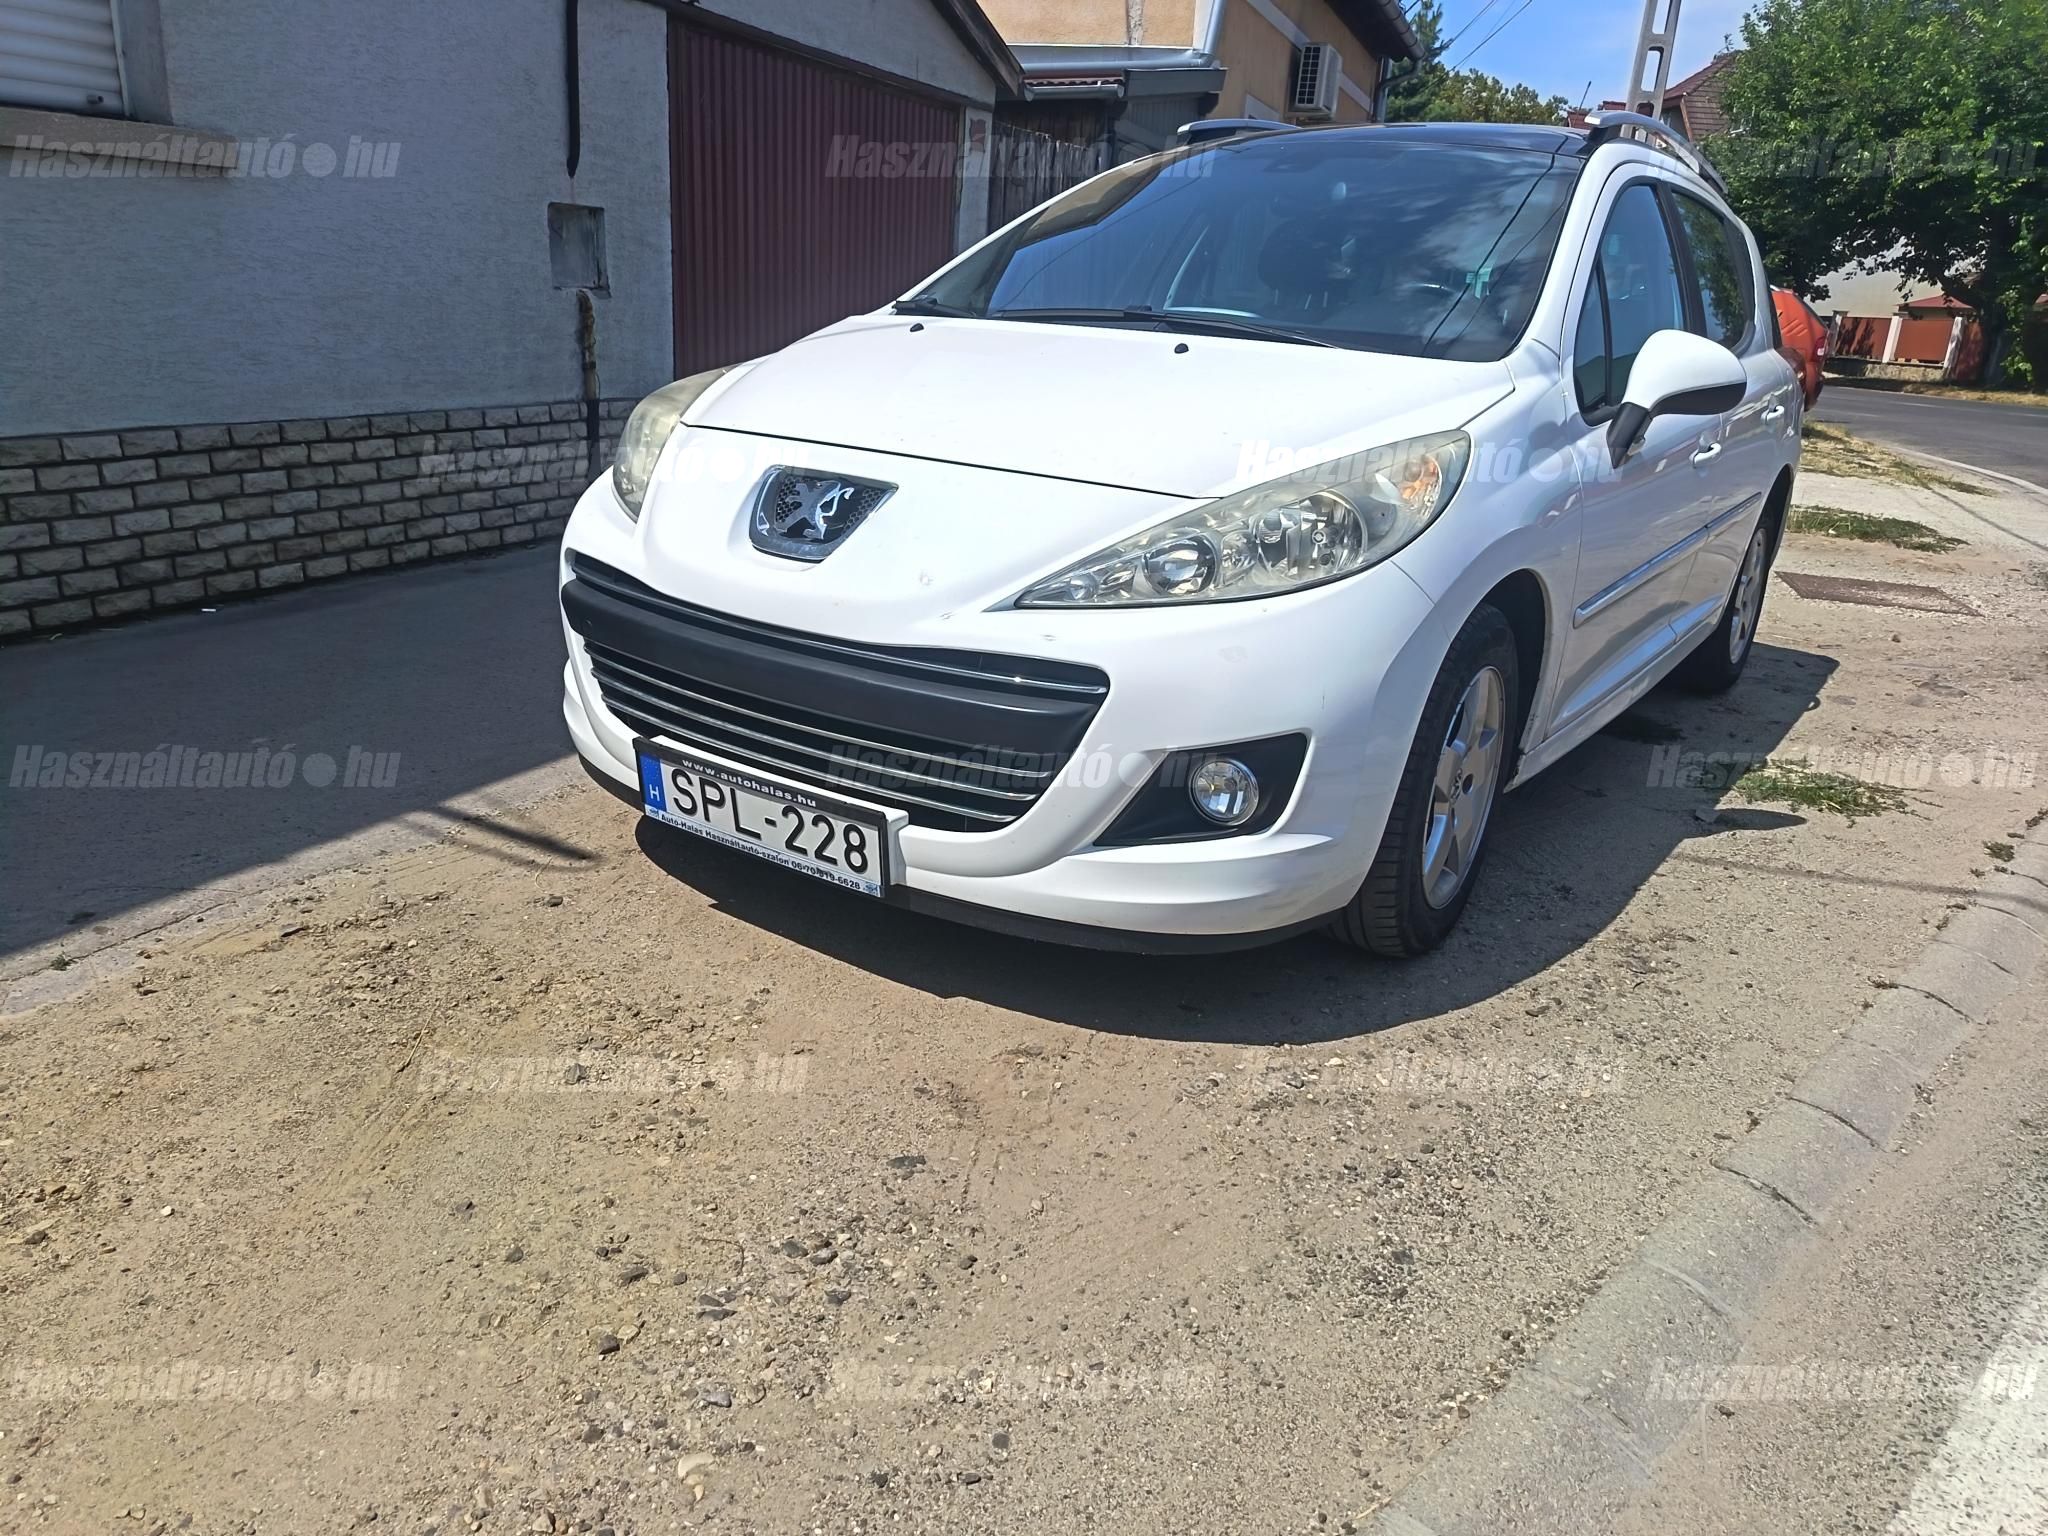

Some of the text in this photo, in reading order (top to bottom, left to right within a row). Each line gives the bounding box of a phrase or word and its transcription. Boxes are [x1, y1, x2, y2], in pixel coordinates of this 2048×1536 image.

[649, 784, 660, 801] H
[682, 760, 817, 808] www.autohalas.hu
[671, 768, 868, 875] SPL-228
